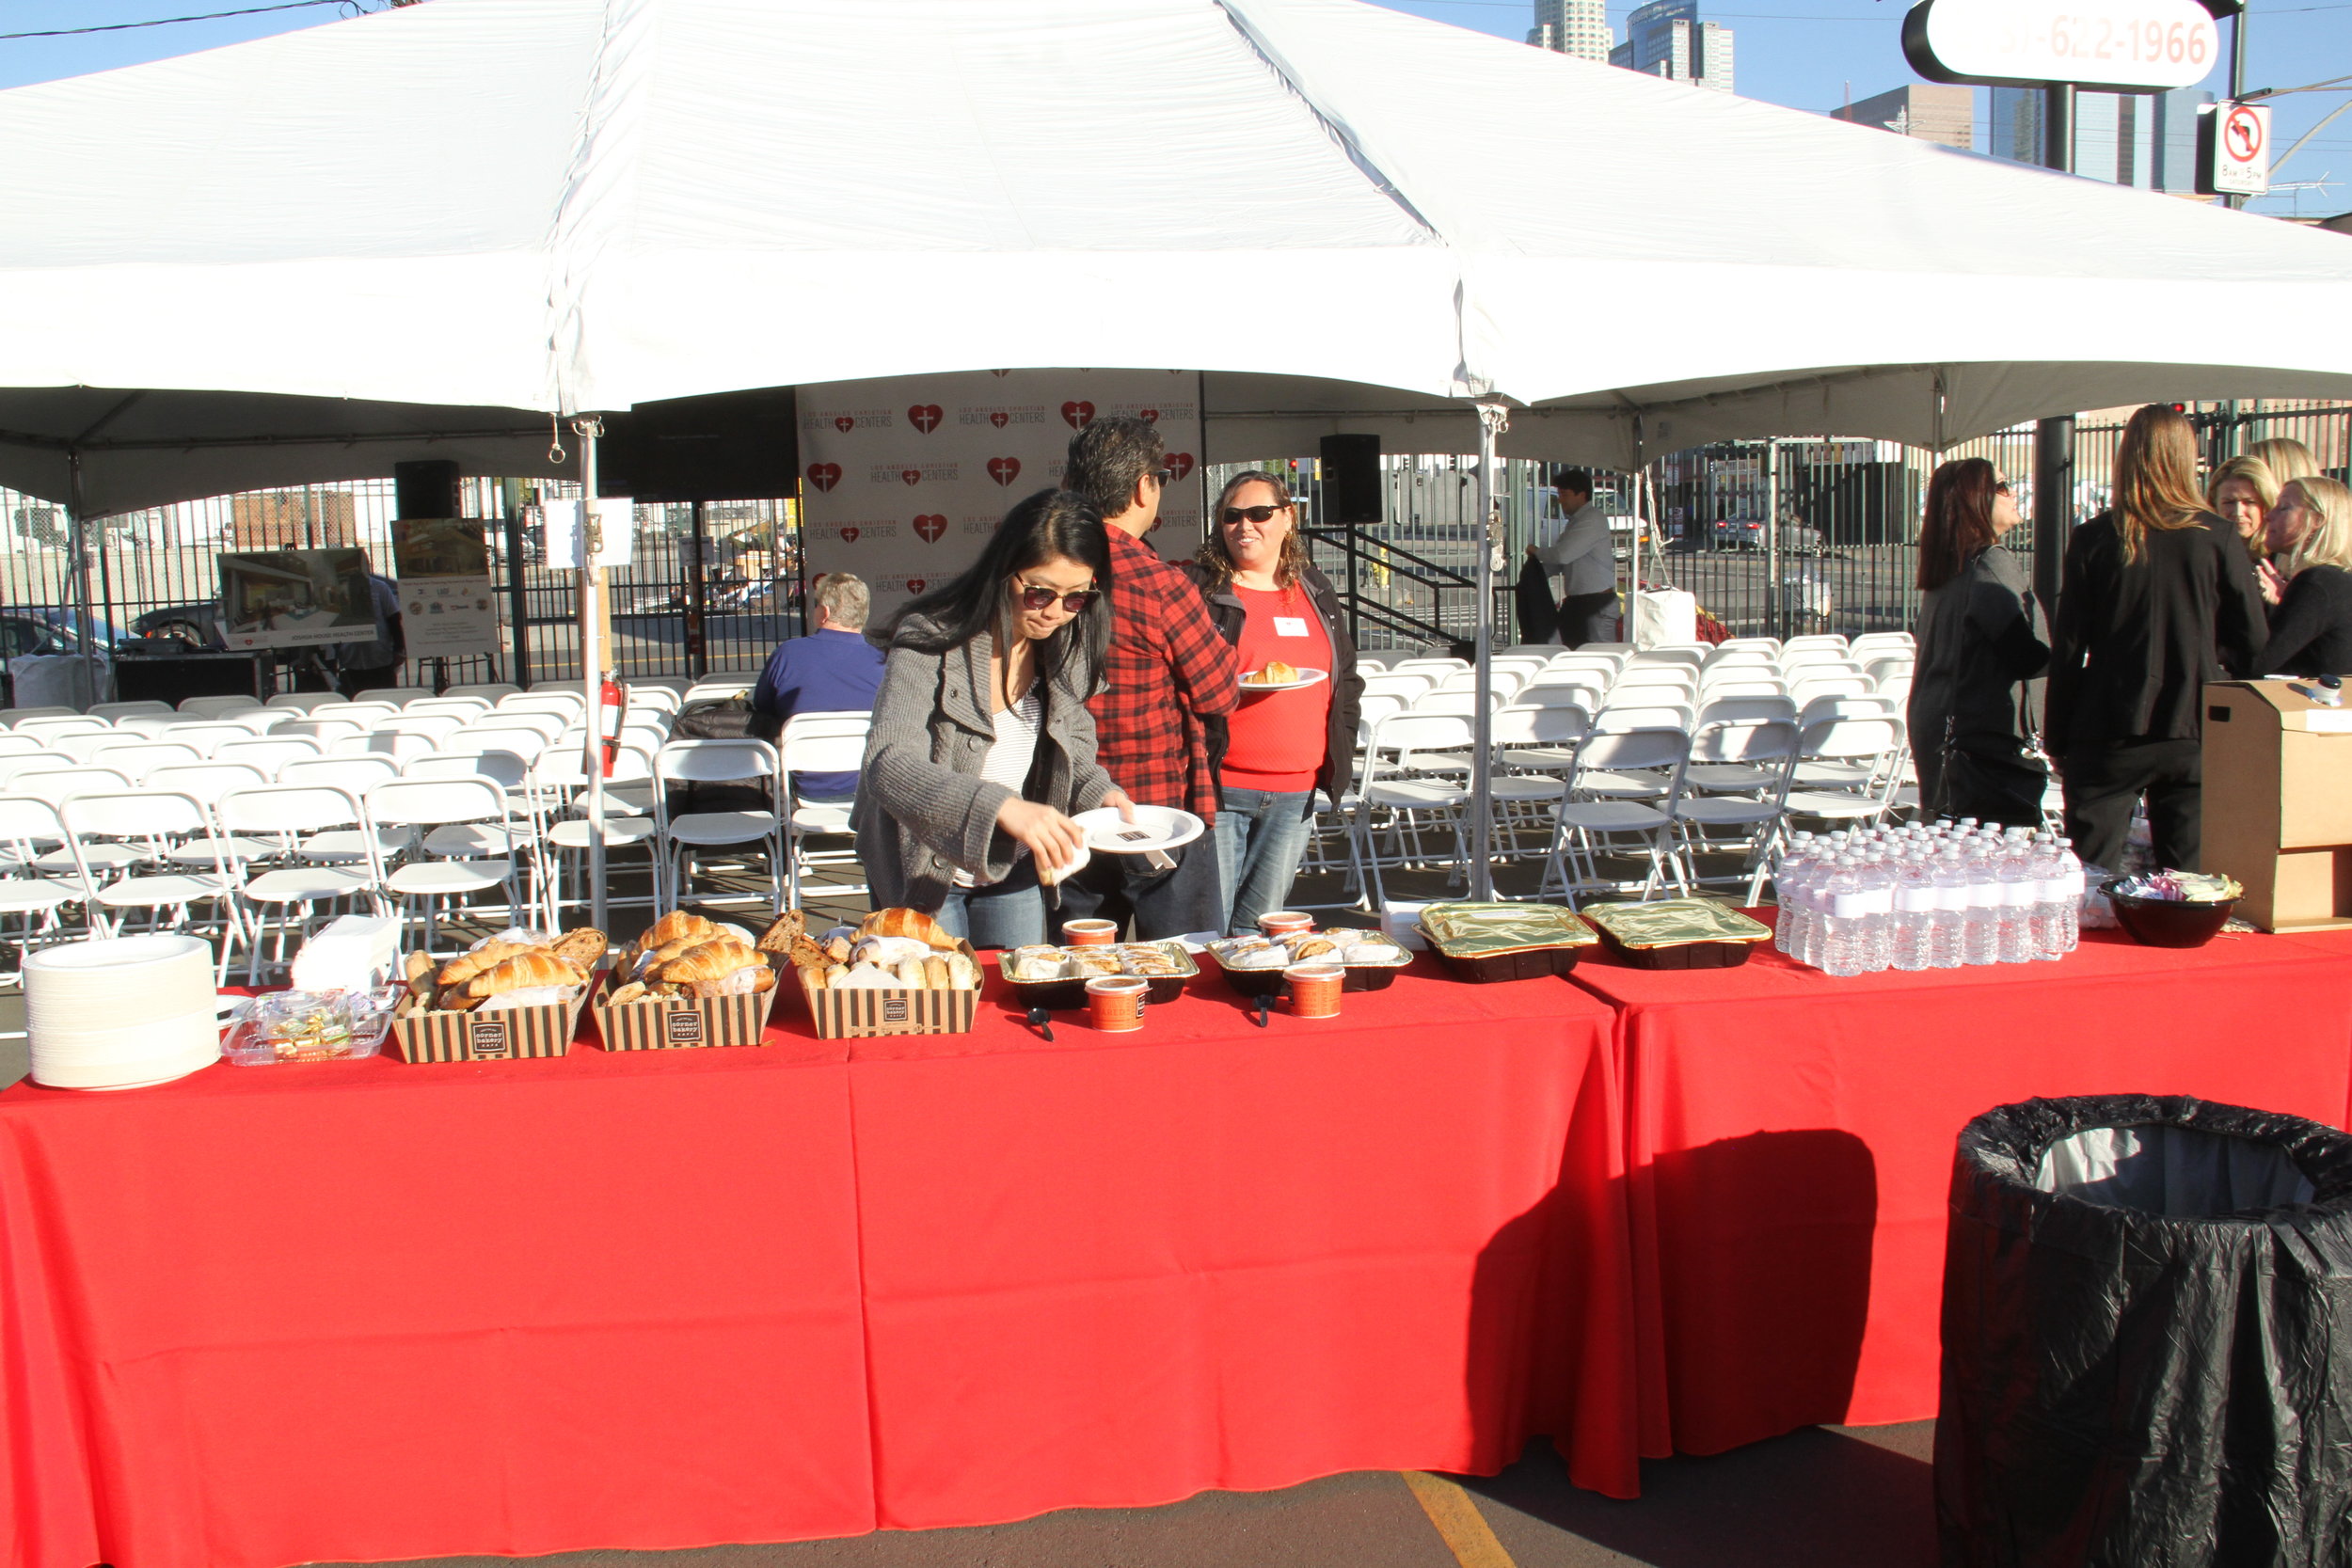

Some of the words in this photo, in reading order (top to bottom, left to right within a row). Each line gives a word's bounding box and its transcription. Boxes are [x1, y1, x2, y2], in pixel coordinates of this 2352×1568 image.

[960, 413, 990, 425] HEALTH
[1009, 412, 1045, 423] CENTERS
[1159, 408, 1194, 420] CENTERS
[803, 418, 834, 430] HEALTH
[854, 416, 892, 429] CENTERS
[870, 471, 901, 483] HEALTH
[922, 469, 959, 482] CENTERS
[1162, 515, 1197, 527] CENTERS
[809, 527, 839, 540] HEALTH
[860, 526, 897, 538] CENTERS
[963, 523, 994, 534] HEALTH
[875, 579, 905, 593] HEALTH
